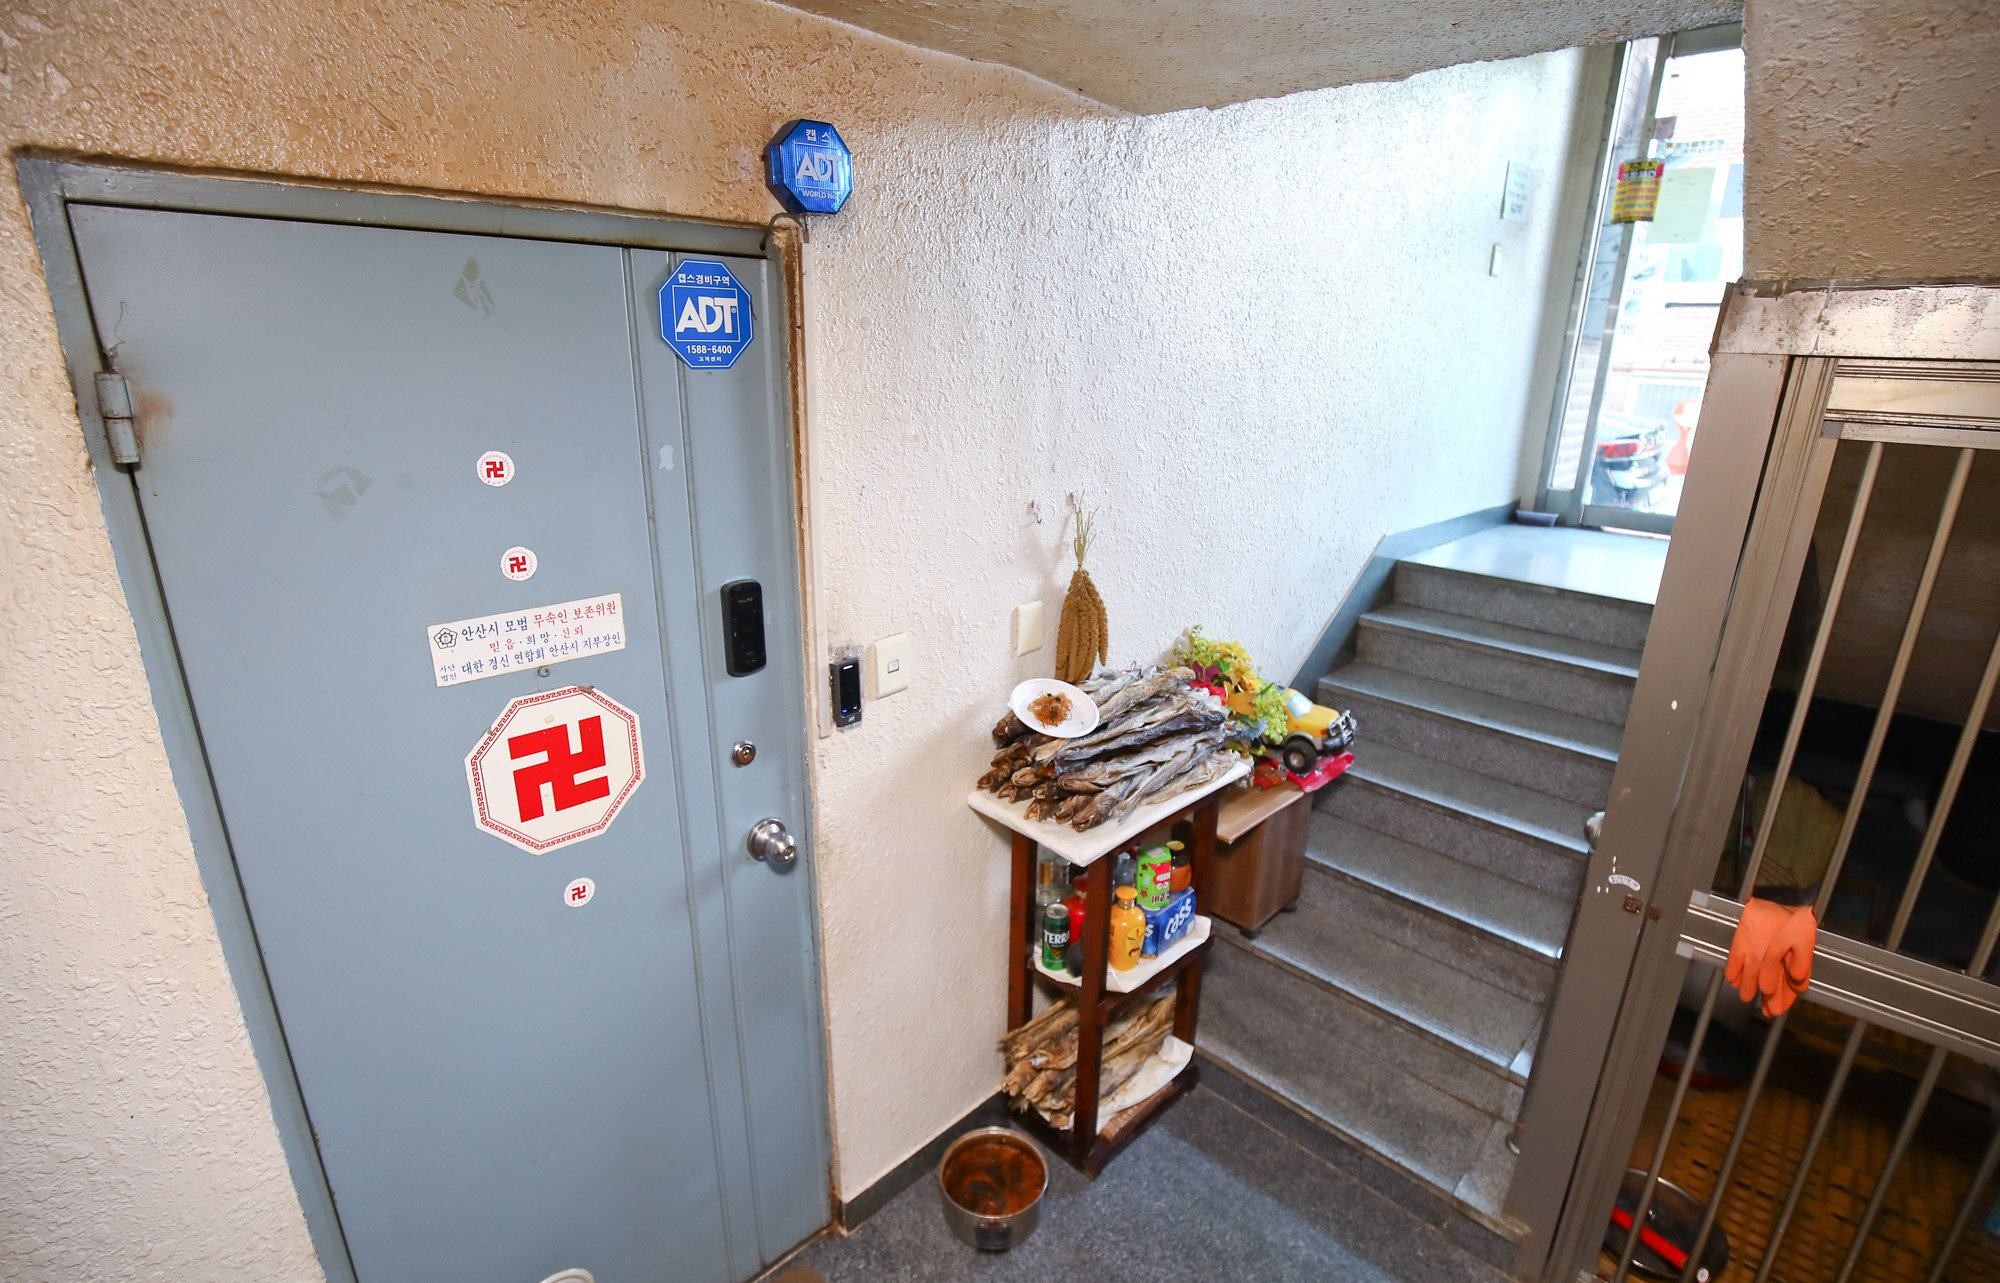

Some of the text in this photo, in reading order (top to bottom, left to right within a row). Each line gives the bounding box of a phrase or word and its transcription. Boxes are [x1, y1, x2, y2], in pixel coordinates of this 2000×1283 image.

[796, 151, 842, 184] ADT
[801, 189, 827, 199] WORLD
[677, 273, 730, 286] 캡스경비구역
[676, 296, 738, 333] ADT
[686, 345, 732, 354] 1588-6400
[461, 600, 617, 642] 안산시 모범 무속인 보존위원
[461, 631, 621, 675] 대한 경신 연합회 안산시 지부장인
[440, 664, 456, 673] 사단
[441, 672, 457, 682] 법인
